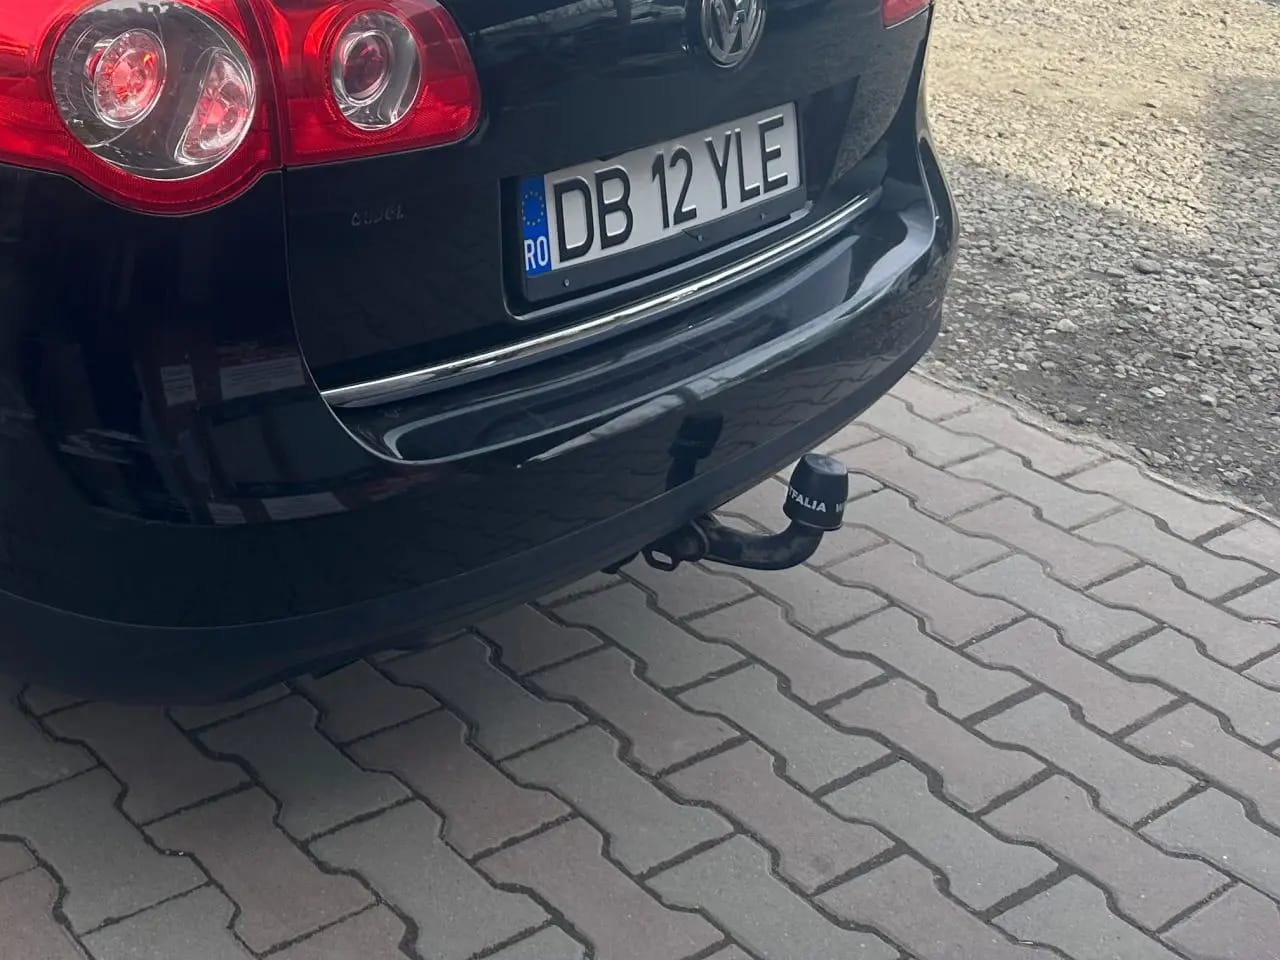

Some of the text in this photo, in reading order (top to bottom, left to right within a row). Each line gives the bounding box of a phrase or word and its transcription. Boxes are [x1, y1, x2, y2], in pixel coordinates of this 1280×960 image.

[552, 113, 789, 263] DB 12 YLE
[524, 236, 549, 271] RO
